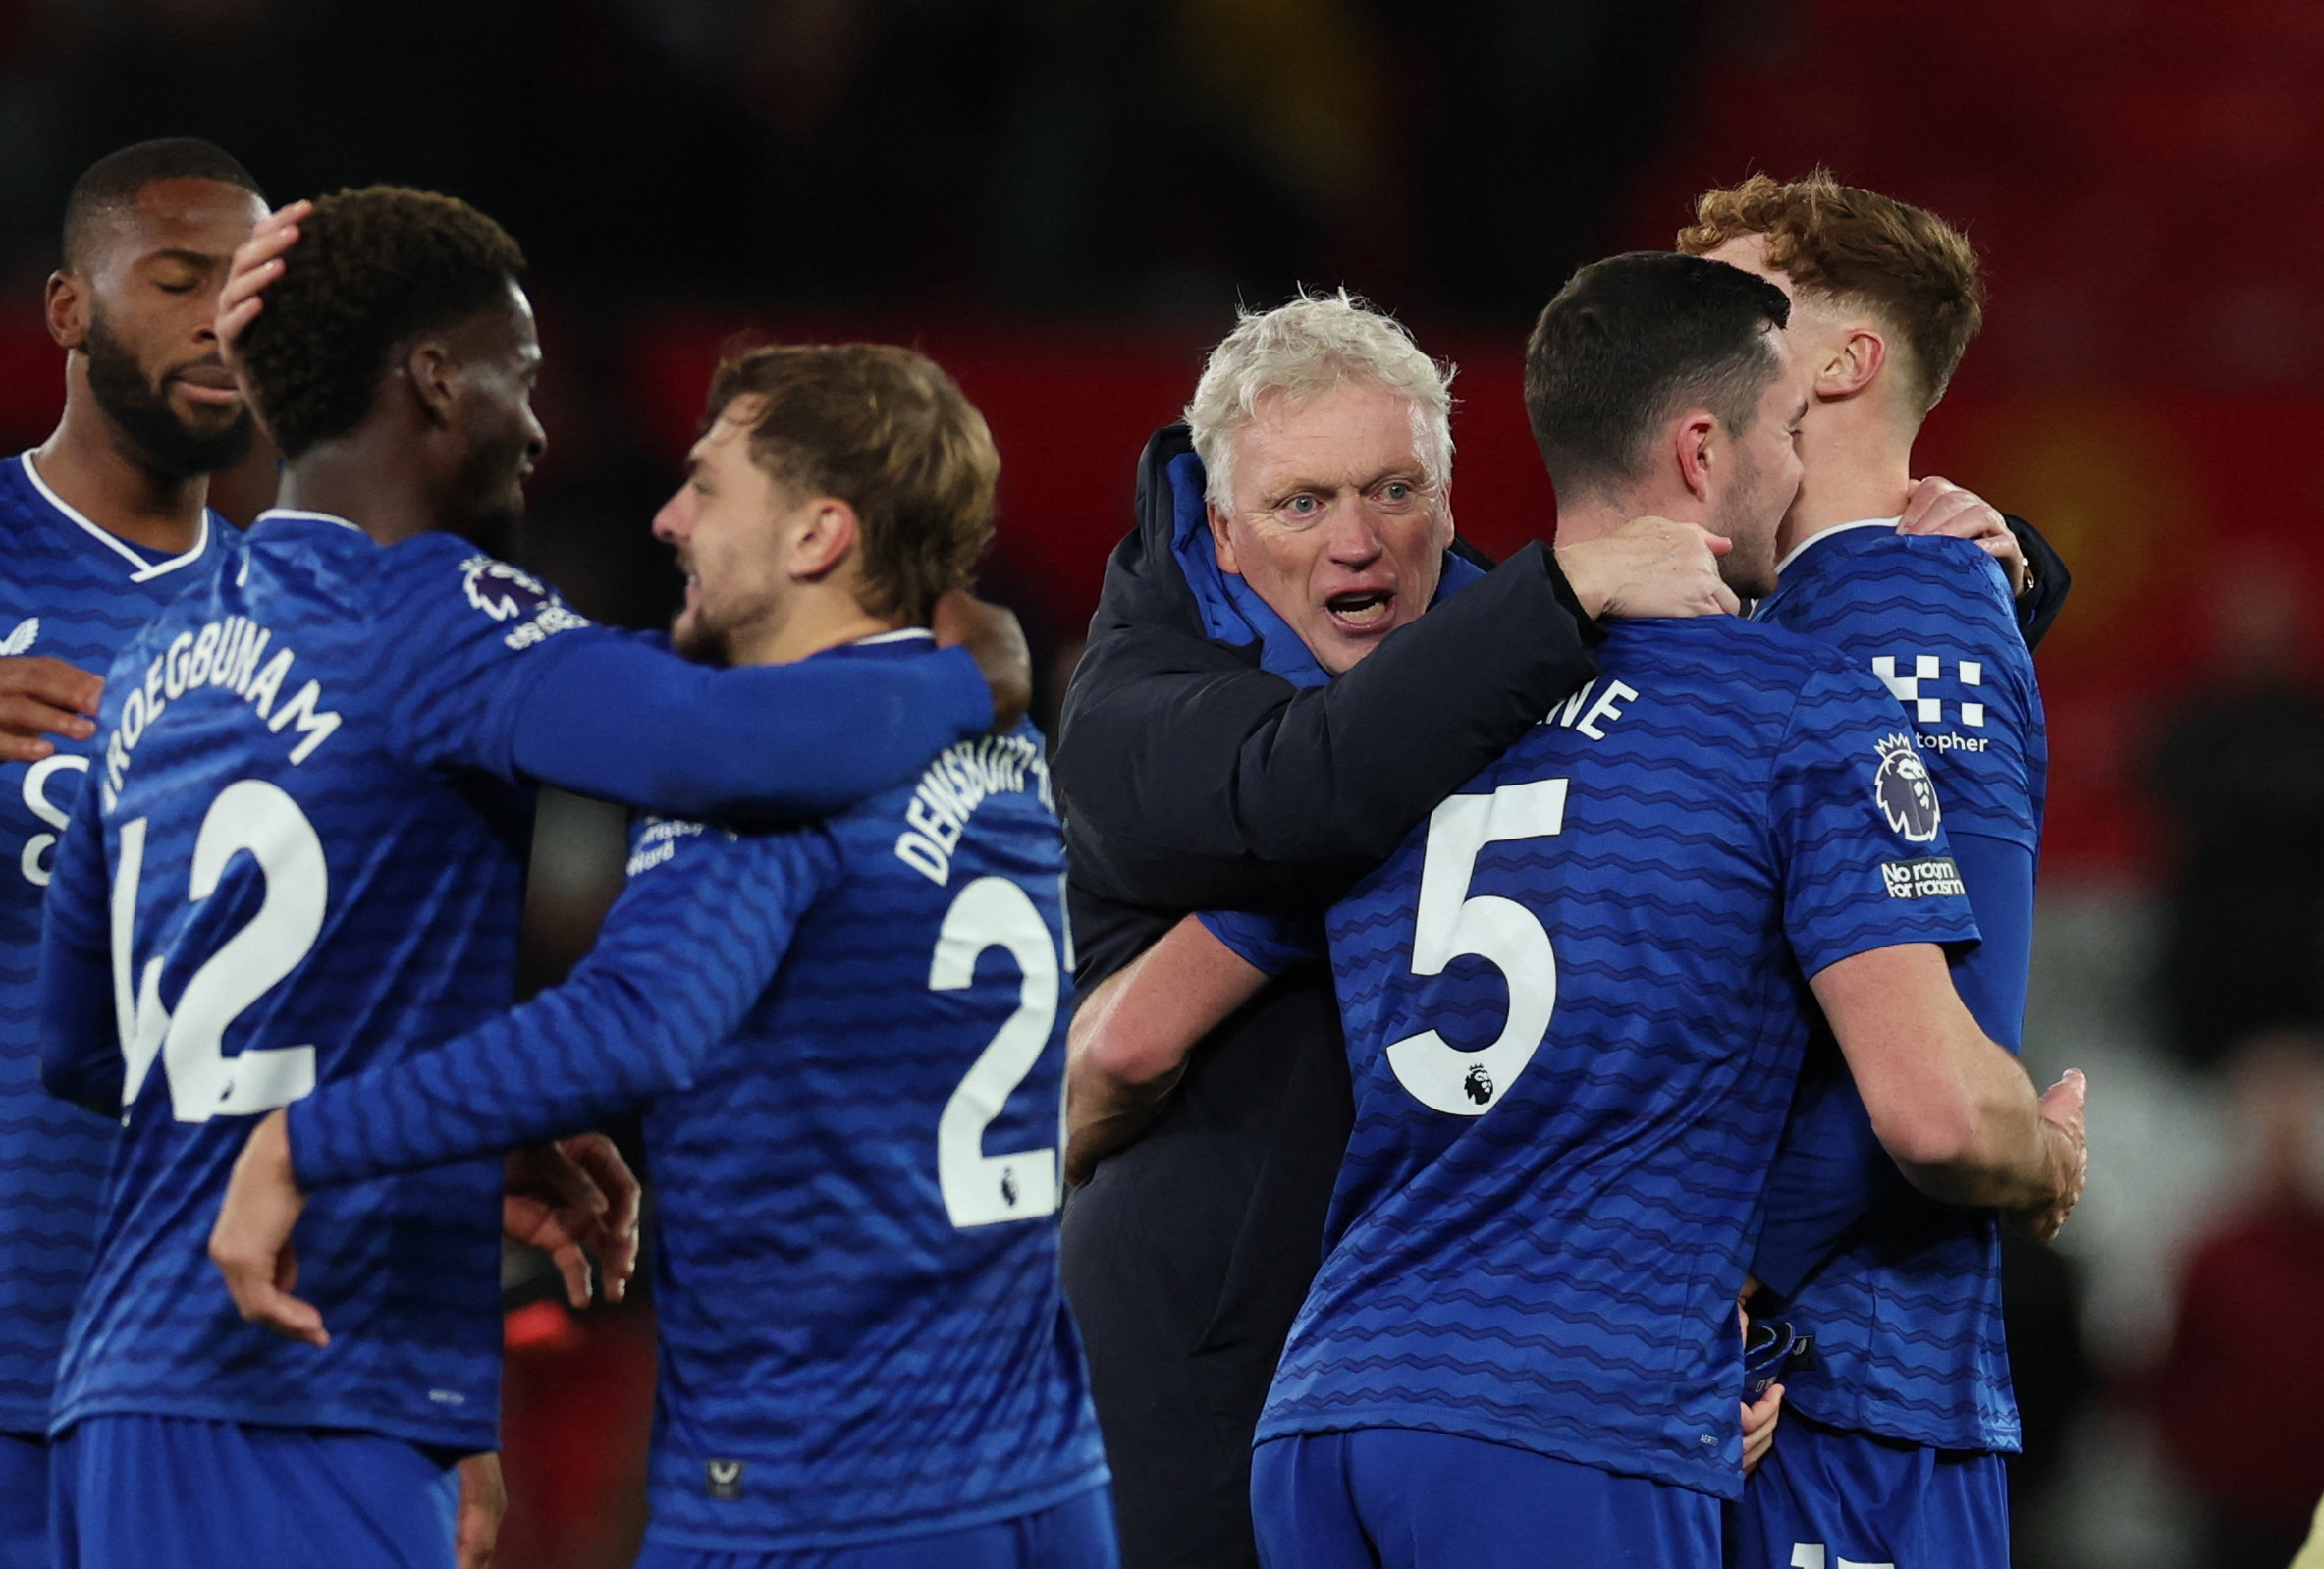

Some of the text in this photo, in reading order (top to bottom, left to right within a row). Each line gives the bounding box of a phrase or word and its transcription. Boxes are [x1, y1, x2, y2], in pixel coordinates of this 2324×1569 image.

[1916, 731, 1989, 754] topher
[1881, 863, 1911, 882] No
[1886, 881, 1913, 897] for
[1385, 778, 1569, 1116] 5
[928, 876, 1075, 1228] 2
